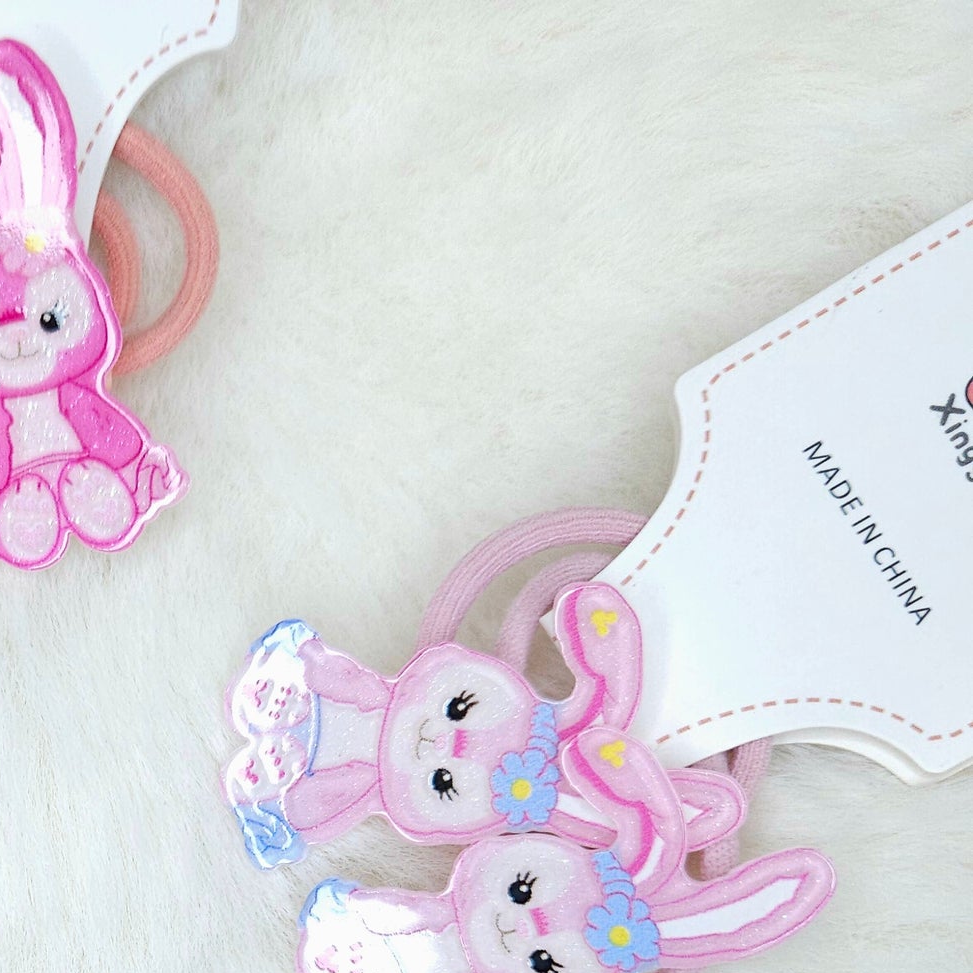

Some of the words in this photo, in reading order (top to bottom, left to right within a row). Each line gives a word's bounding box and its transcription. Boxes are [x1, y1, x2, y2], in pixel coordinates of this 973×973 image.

[802, 440, 864, 515] MADE
[852, 514, 883, 545] IN
[873, 546, 932, 626] CHINA
